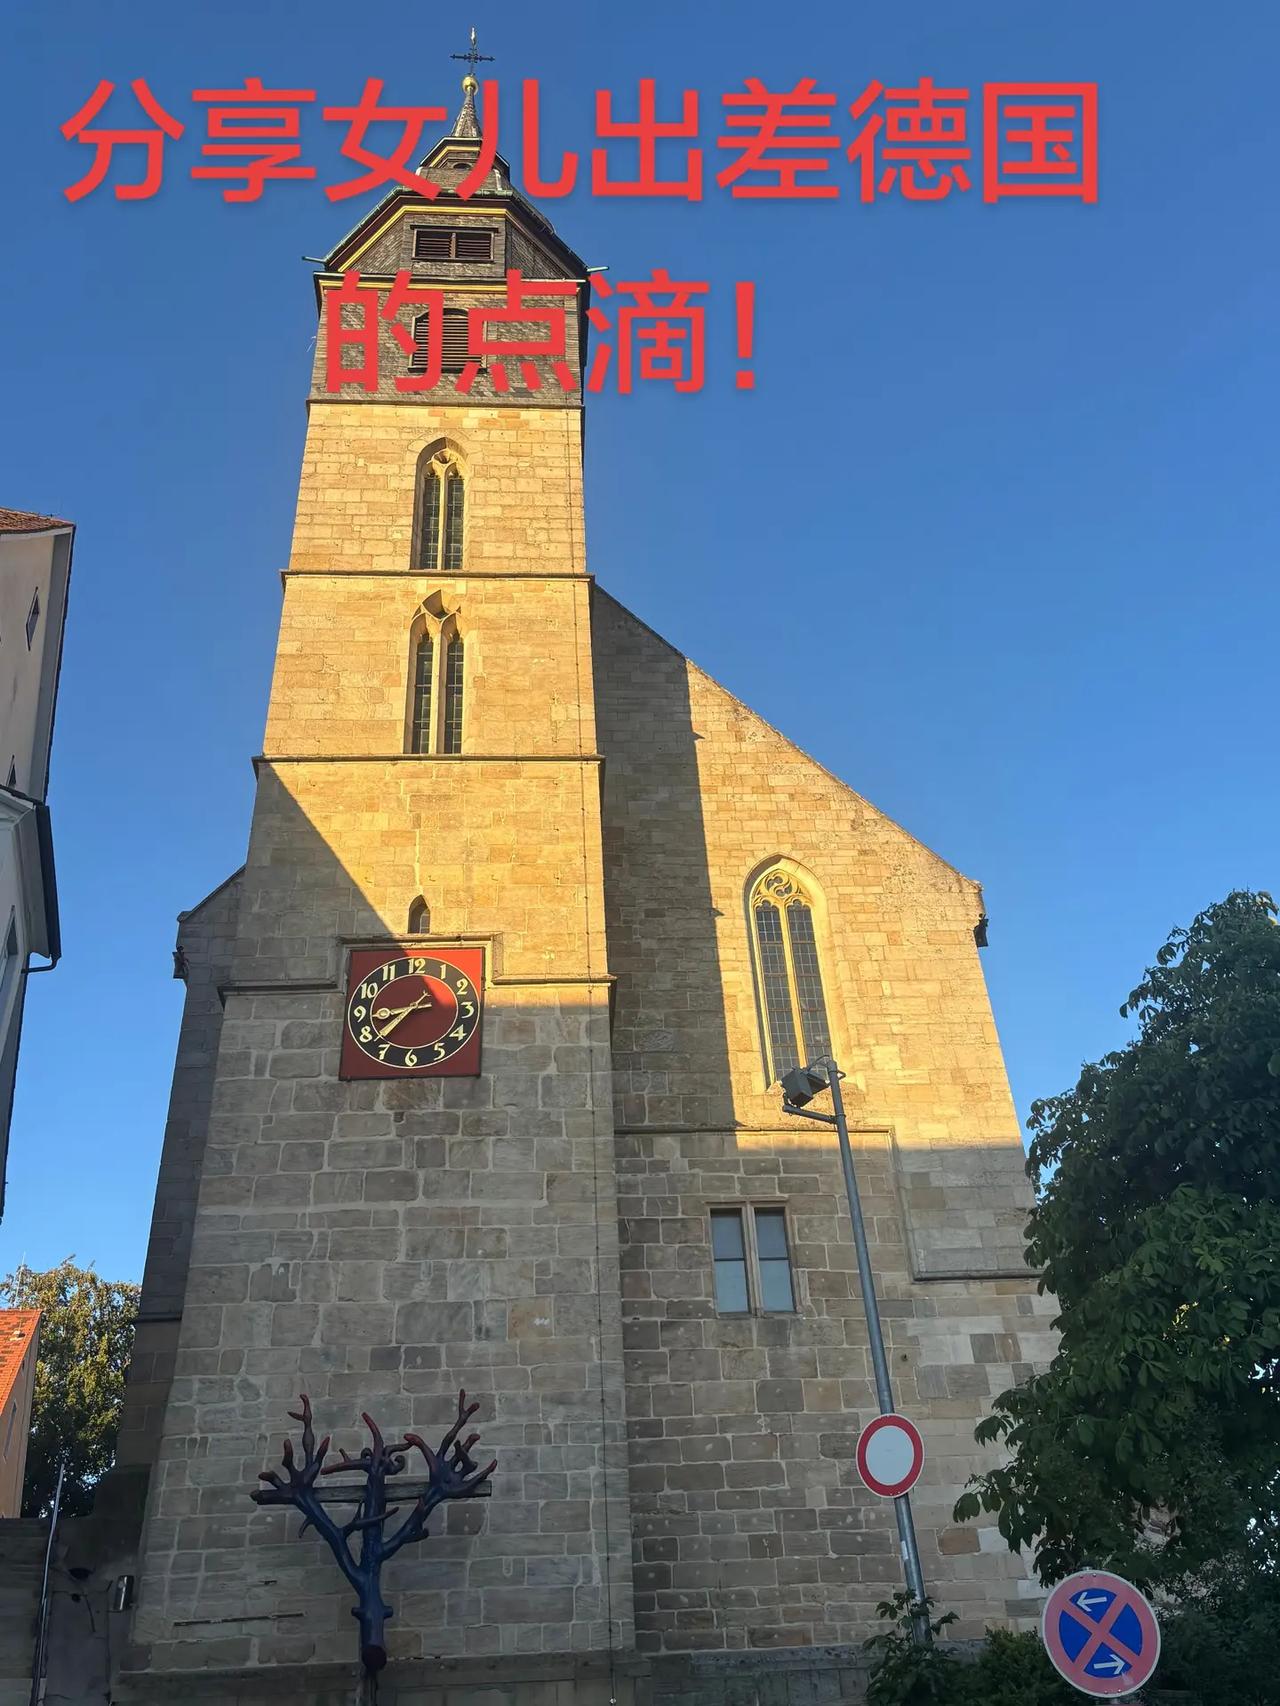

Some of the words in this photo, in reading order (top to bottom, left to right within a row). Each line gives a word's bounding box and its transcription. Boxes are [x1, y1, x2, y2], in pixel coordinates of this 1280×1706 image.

[382, 964, 396, 982] 11
[408, 958, 426, 974] 12
[440, 964, 447, 980] 1
[361, 982, 379, 999] 10
[456, 978, 469, 995] 2
[354, 1005, 367, 1023] 9
[461, 1001, 475, 1019] 3
[359, 1025, 373, 1043] 8
[449, 1024, 467, 1041] 4
[378, 1043, 391, 1060] 7
[404, 1048, 418, 1067] 6
[434, 1042, 445, 1061] 5
